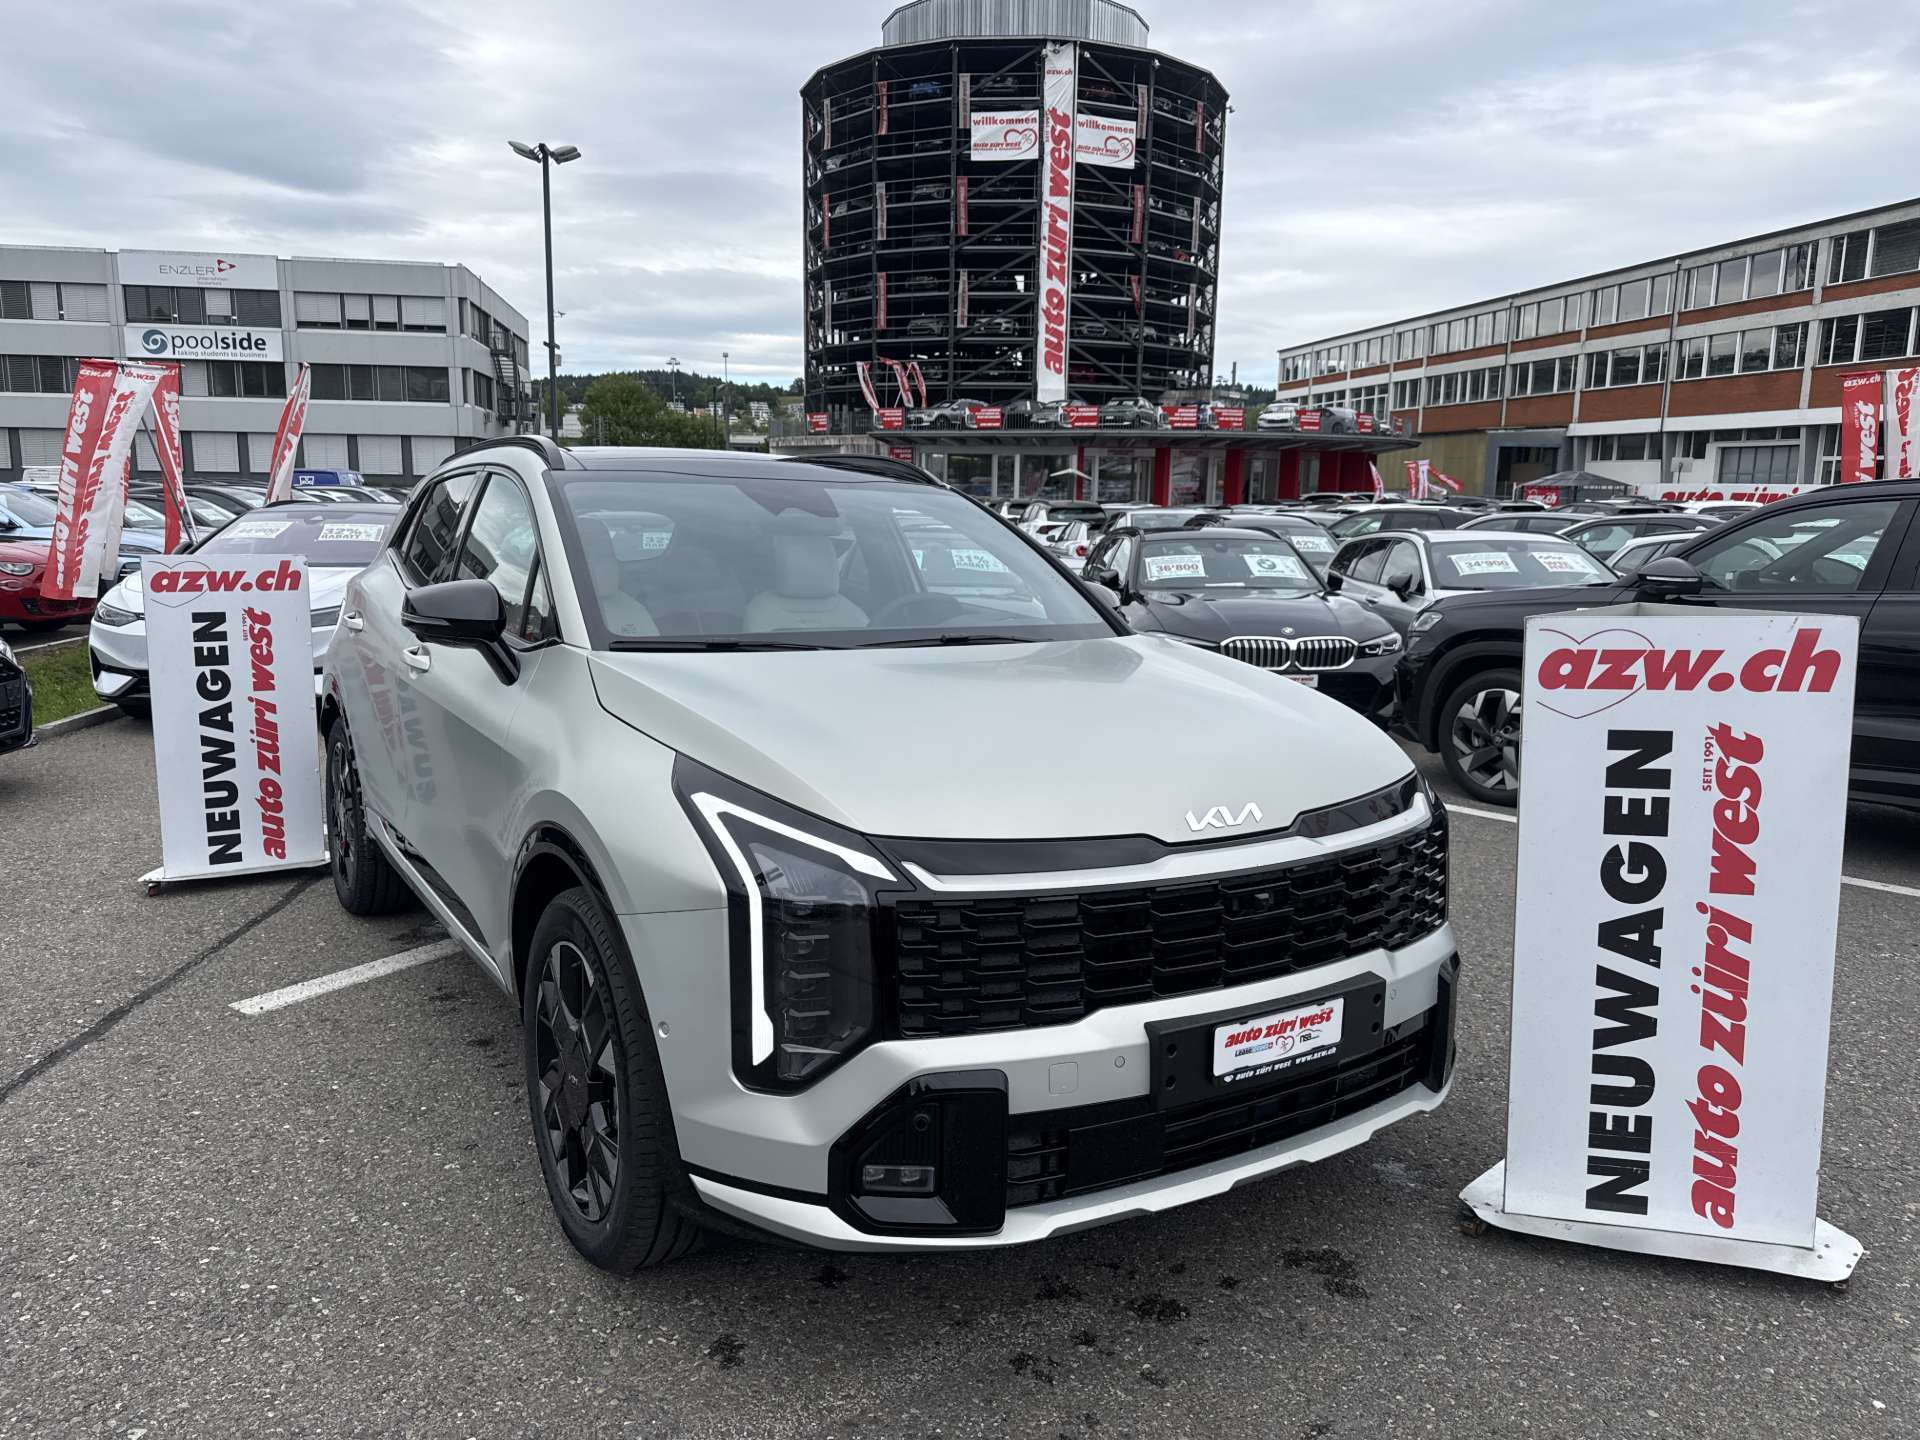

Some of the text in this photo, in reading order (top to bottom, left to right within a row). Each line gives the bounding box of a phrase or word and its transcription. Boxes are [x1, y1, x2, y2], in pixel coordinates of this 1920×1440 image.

[973, 116, 1038, 126] willkommen
[1077, 119, 1135, 134] willkommen
[1041, 107, 1072, 375] auto züri west
[159, 265, 215, 276] ENZLER
[171, 331, 267, 355] poolside
[239, 351, 268, 359] business
[1843, 373, 1880, 388] azw.ch
[66, 388, 94, 454] west
[1855, 399, 1876, 469] west
[150, 560, 302, 593] azw.ch
[1156, 563, 1199, 572] 36'800
[1538, 628, 1841, 693] azw.ch
[191, 611, 243, 866] NEUWAGEN
[244, 606, 288, 860] auto züri west
[1702, 736, 1715, 792] SEIT 1991
[1585, 729, 1674, 1216] NEUWAGEN
[1685, 722, 1764, 1231] auto züri west
[1225, 1007, 1334, 1048] auto züri west
[1235, 1046, 1337, 1081] auto züri west www.azw.ch
